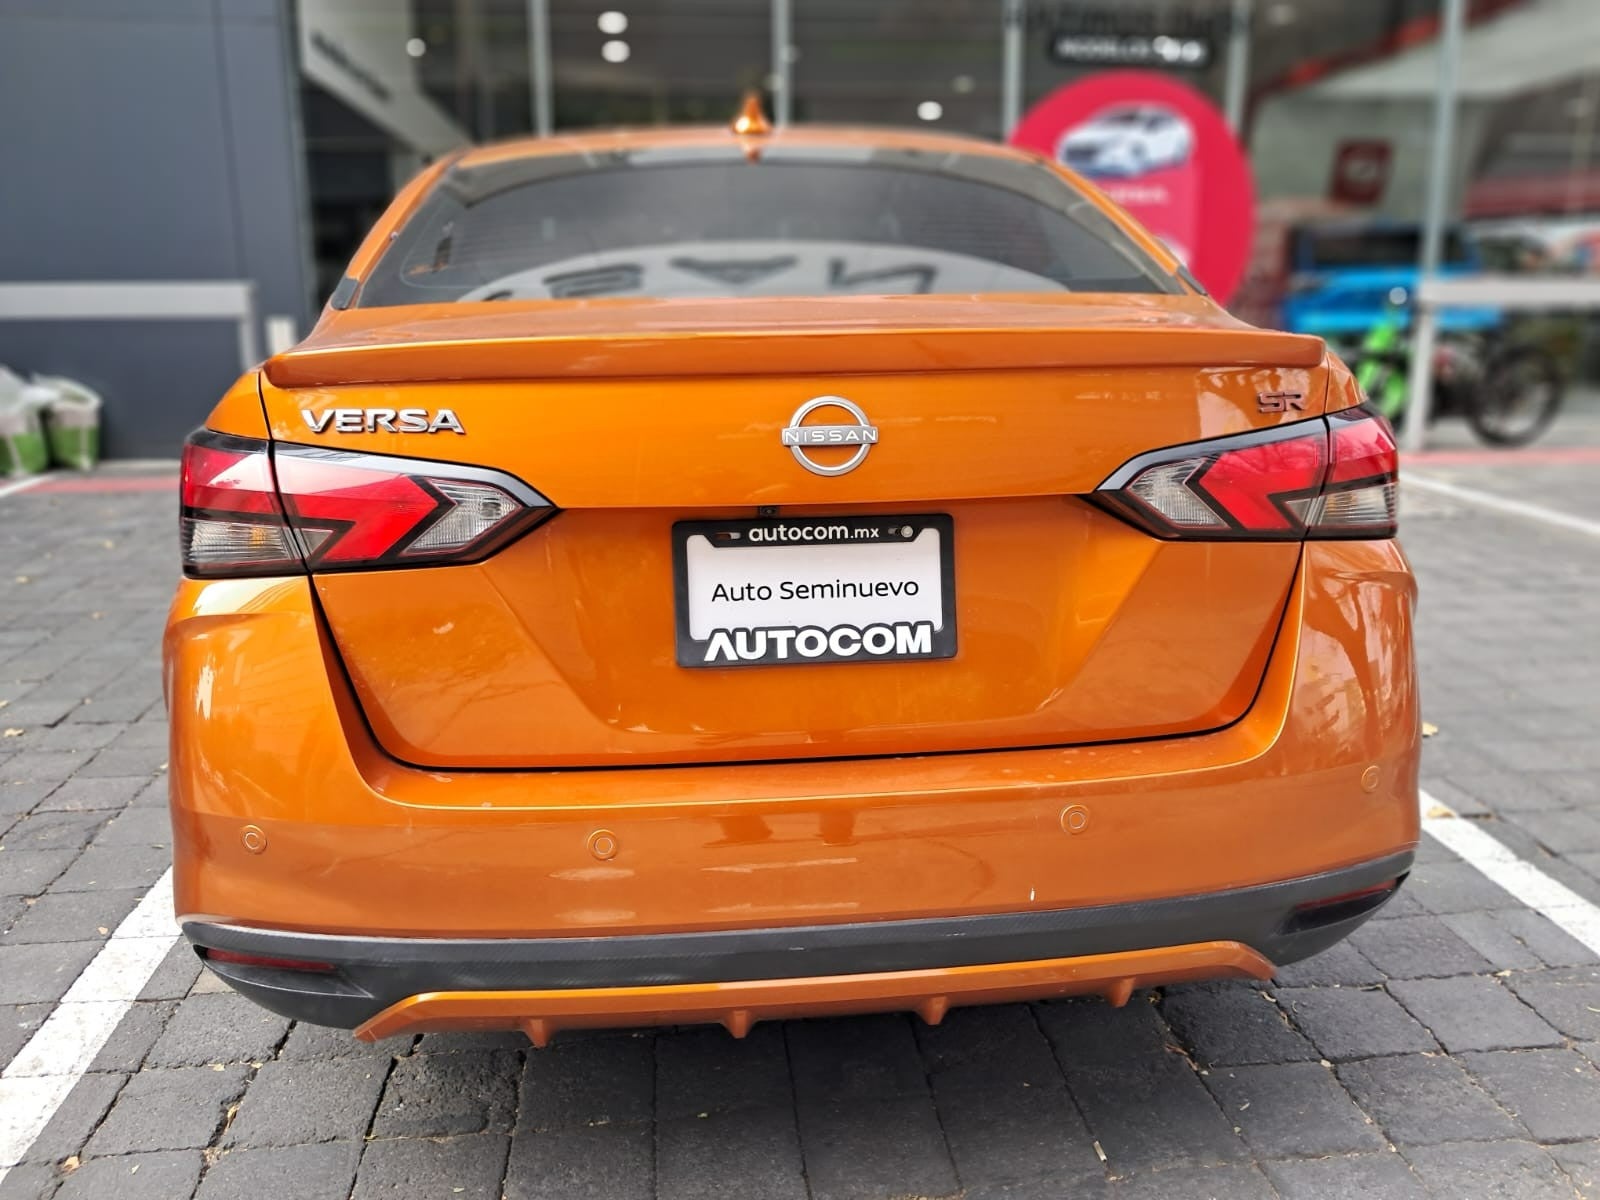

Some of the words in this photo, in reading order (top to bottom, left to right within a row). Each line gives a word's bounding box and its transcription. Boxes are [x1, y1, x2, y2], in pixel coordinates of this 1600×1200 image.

[1258, 391, 1306, 413] SR
[301, 408, 466, 434] VERSA
[784, 429, 876, 443] NISSAN
[748, 523, 880, 542] autocom.mx
[711, 582, 773, 602] Auto
[779, 578, 919, 600] Seminuevo
[703, 624, 932, 662] AUTOCOM
